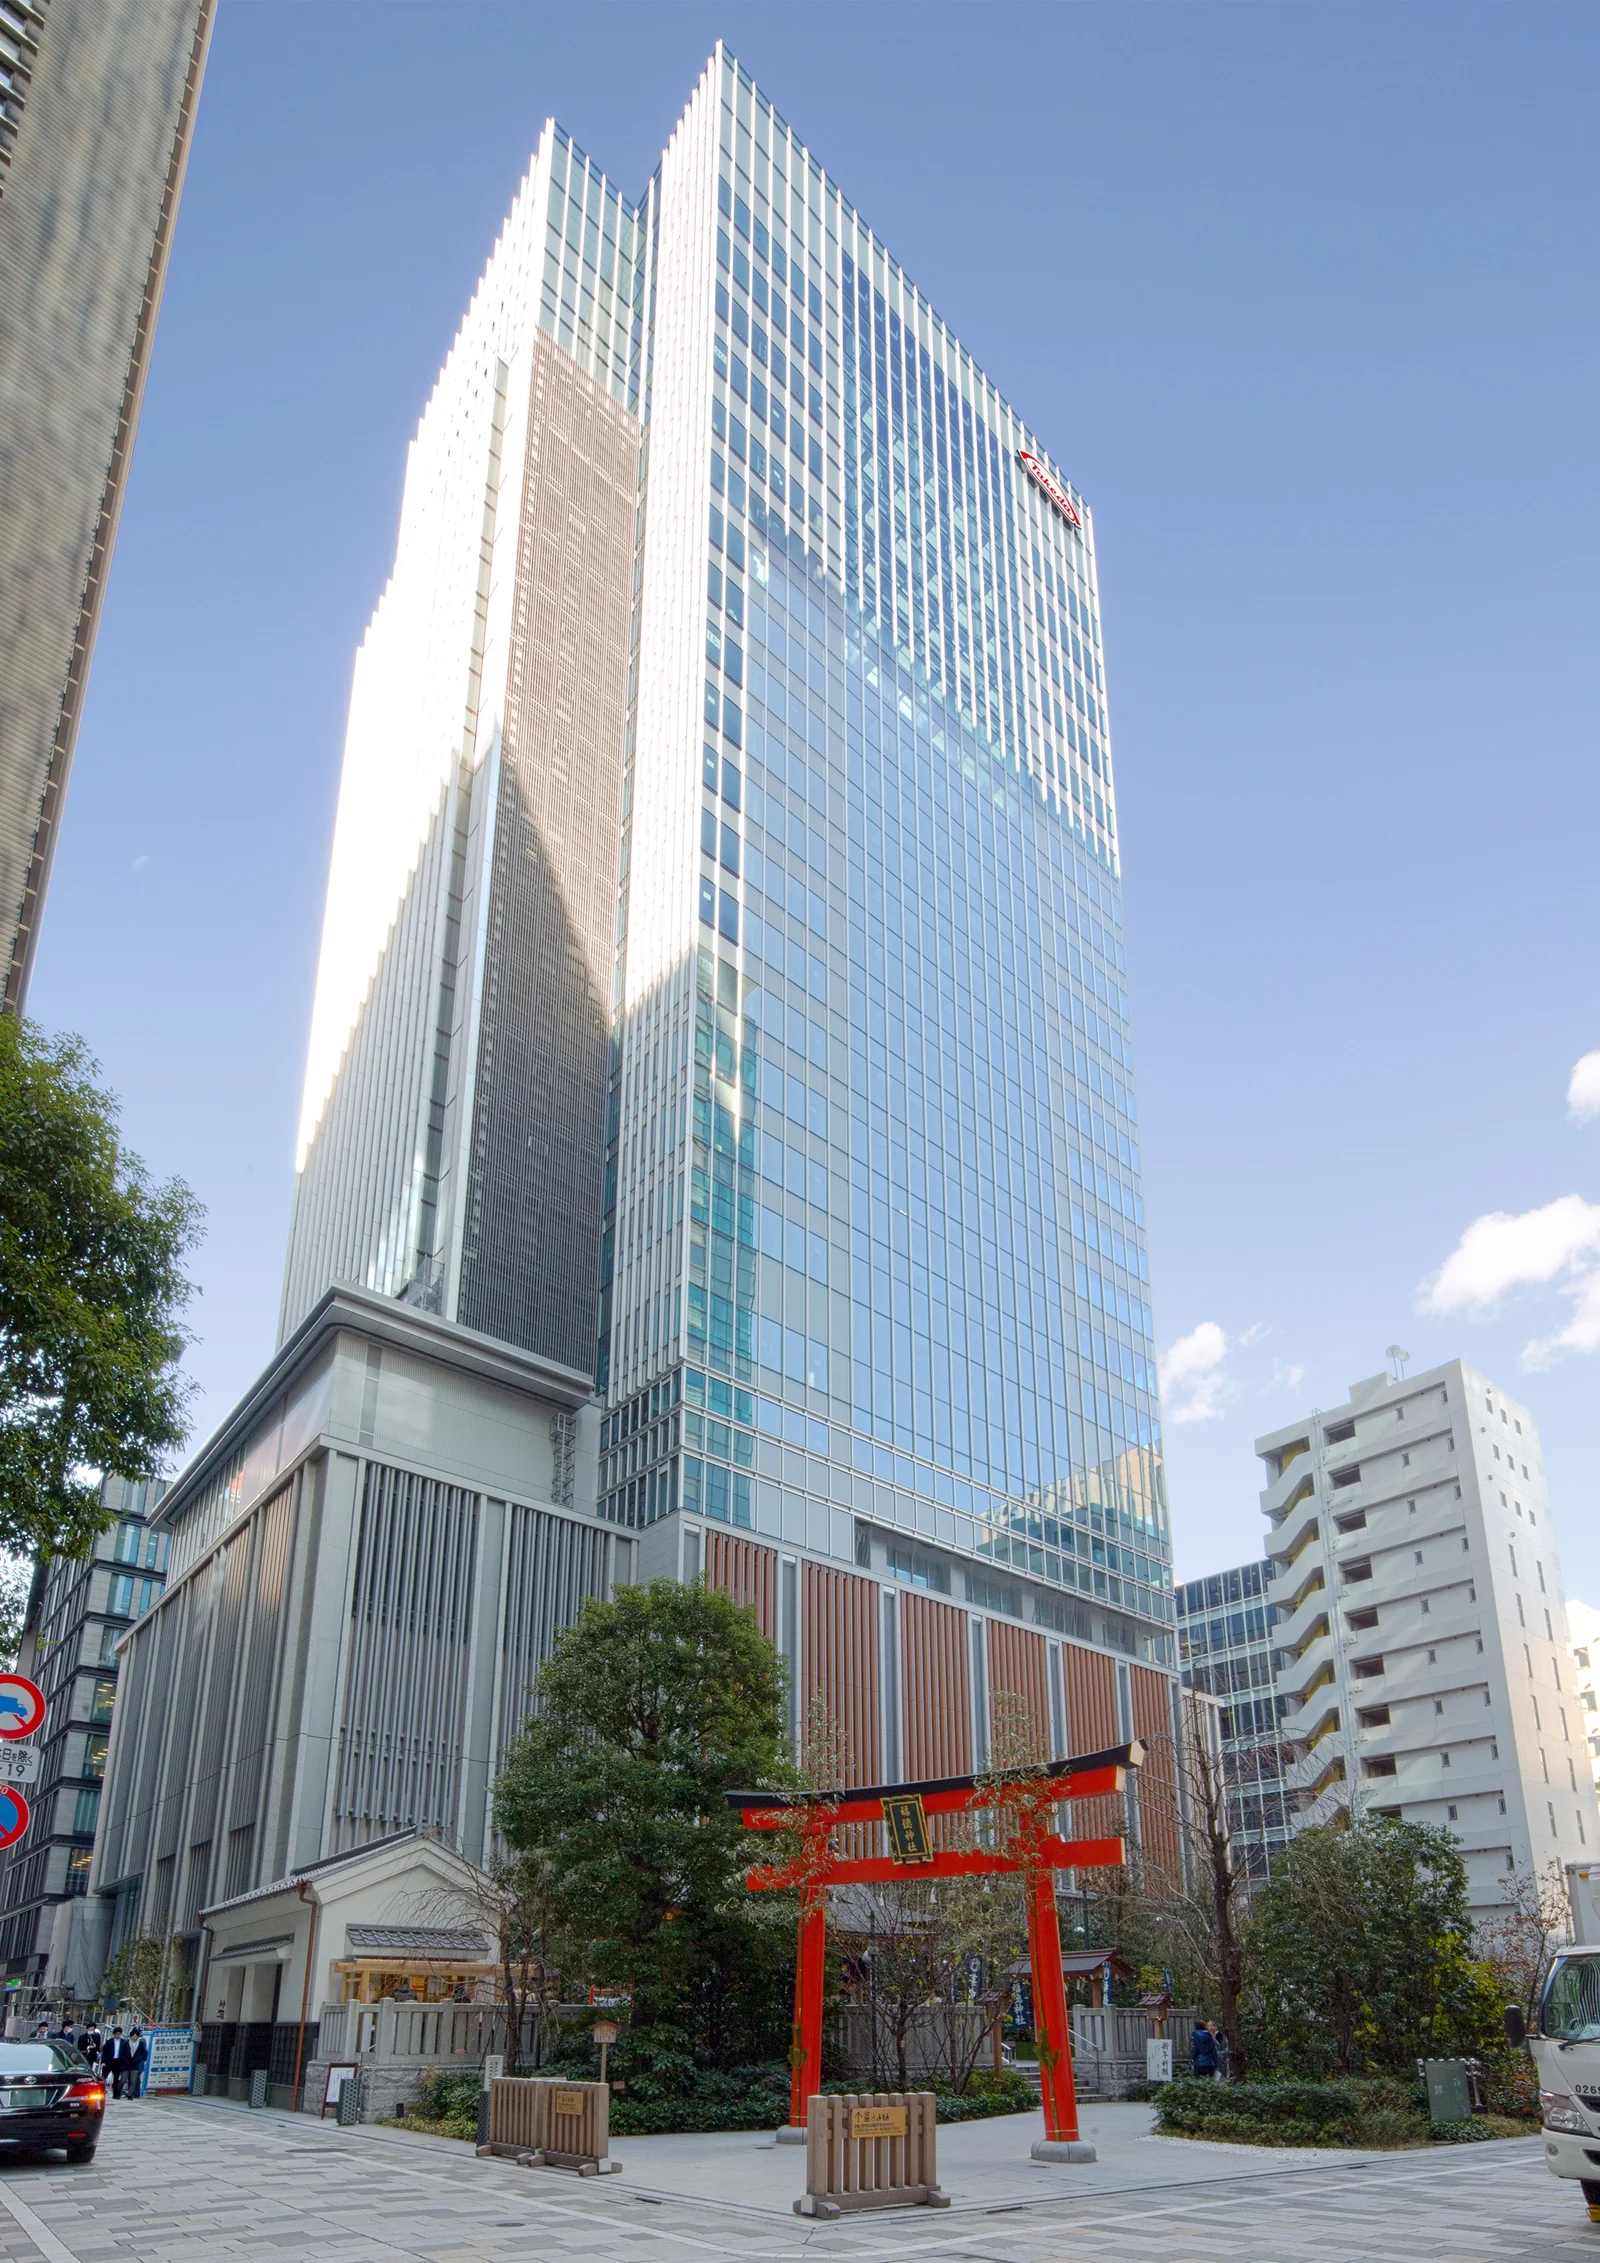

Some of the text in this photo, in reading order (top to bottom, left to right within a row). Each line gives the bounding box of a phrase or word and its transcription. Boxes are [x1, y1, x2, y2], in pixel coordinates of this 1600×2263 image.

[1031, 460, 1072, 514] Takeda
[0, 1747, 33, 1764] 日を除く
